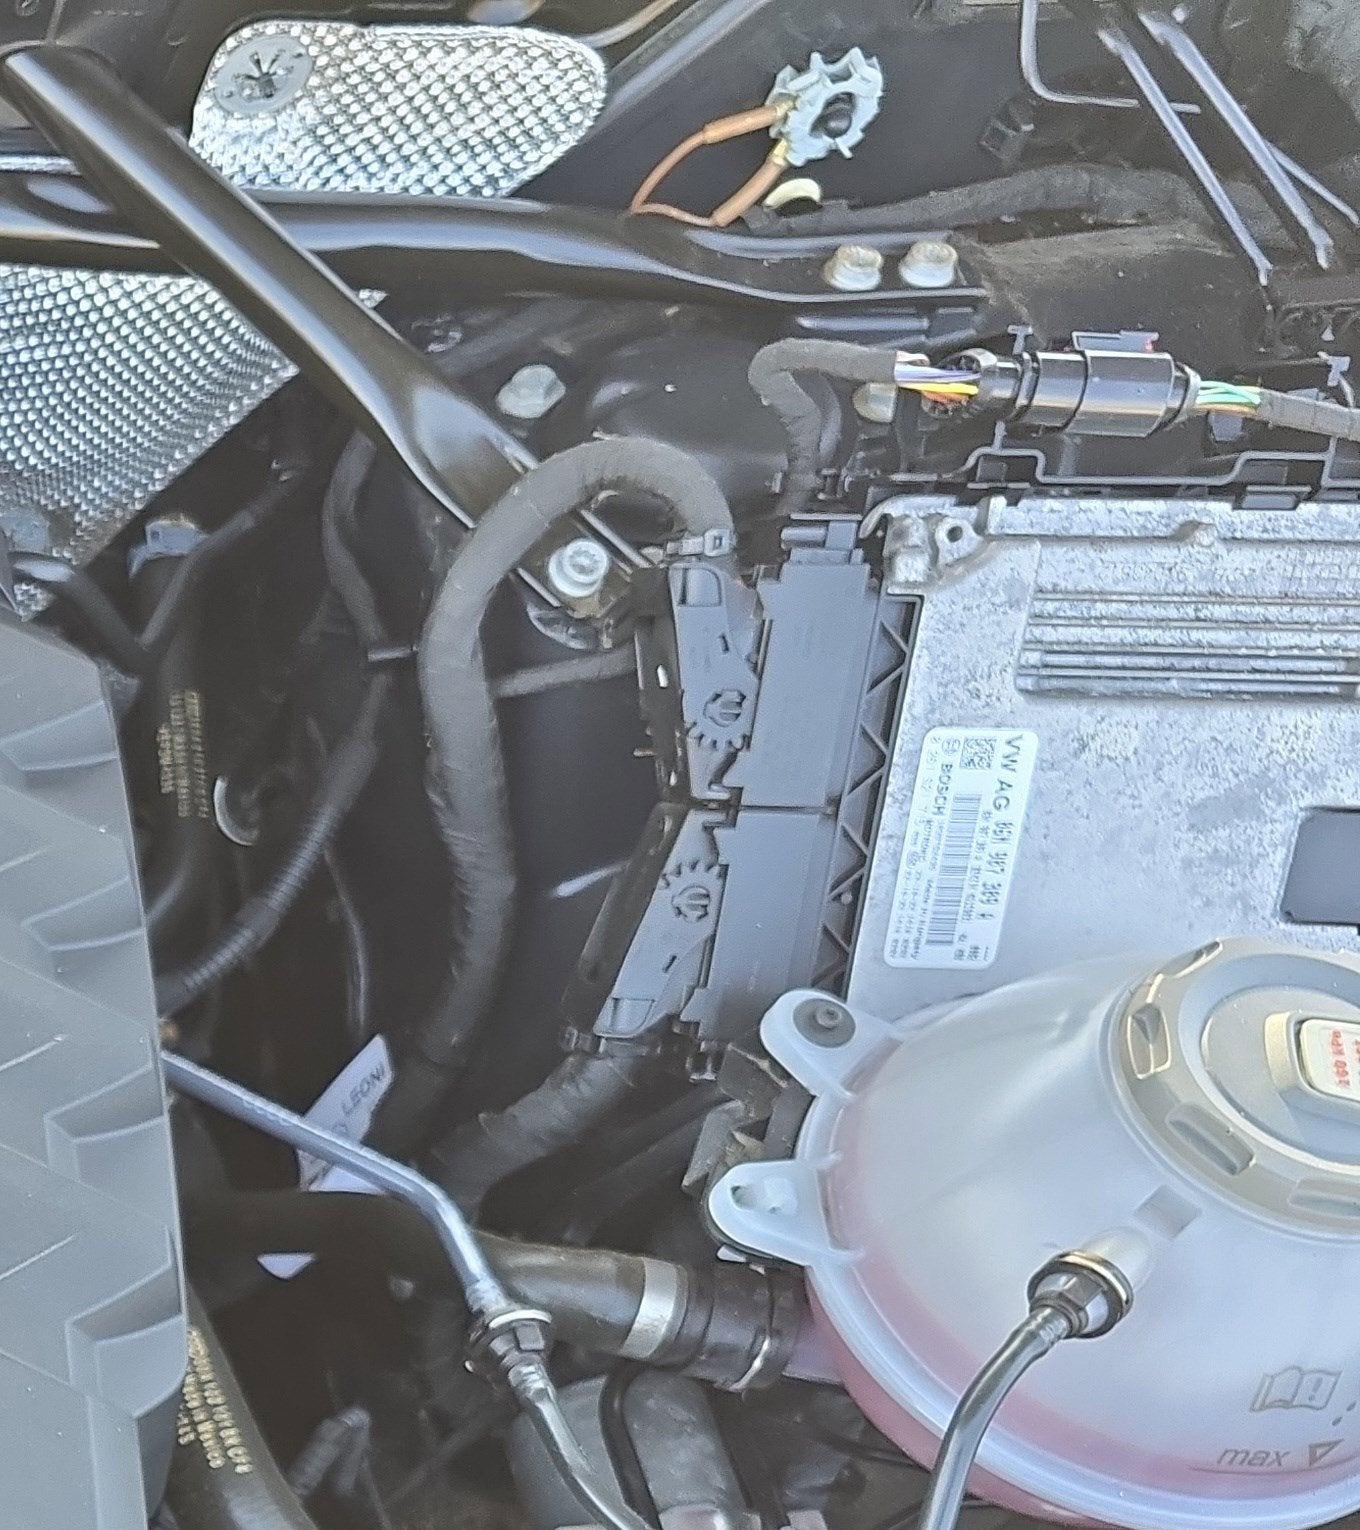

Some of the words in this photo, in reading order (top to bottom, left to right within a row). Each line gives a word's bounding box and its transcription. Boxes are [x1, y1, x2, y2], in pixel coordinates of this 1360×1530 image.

[1003, 734, 1024, 773] VW
[931, 763, 953, 816] BOSCH
[992, 779, 1011, 812] AG
[1215, 1447, 1290, 1468] max
